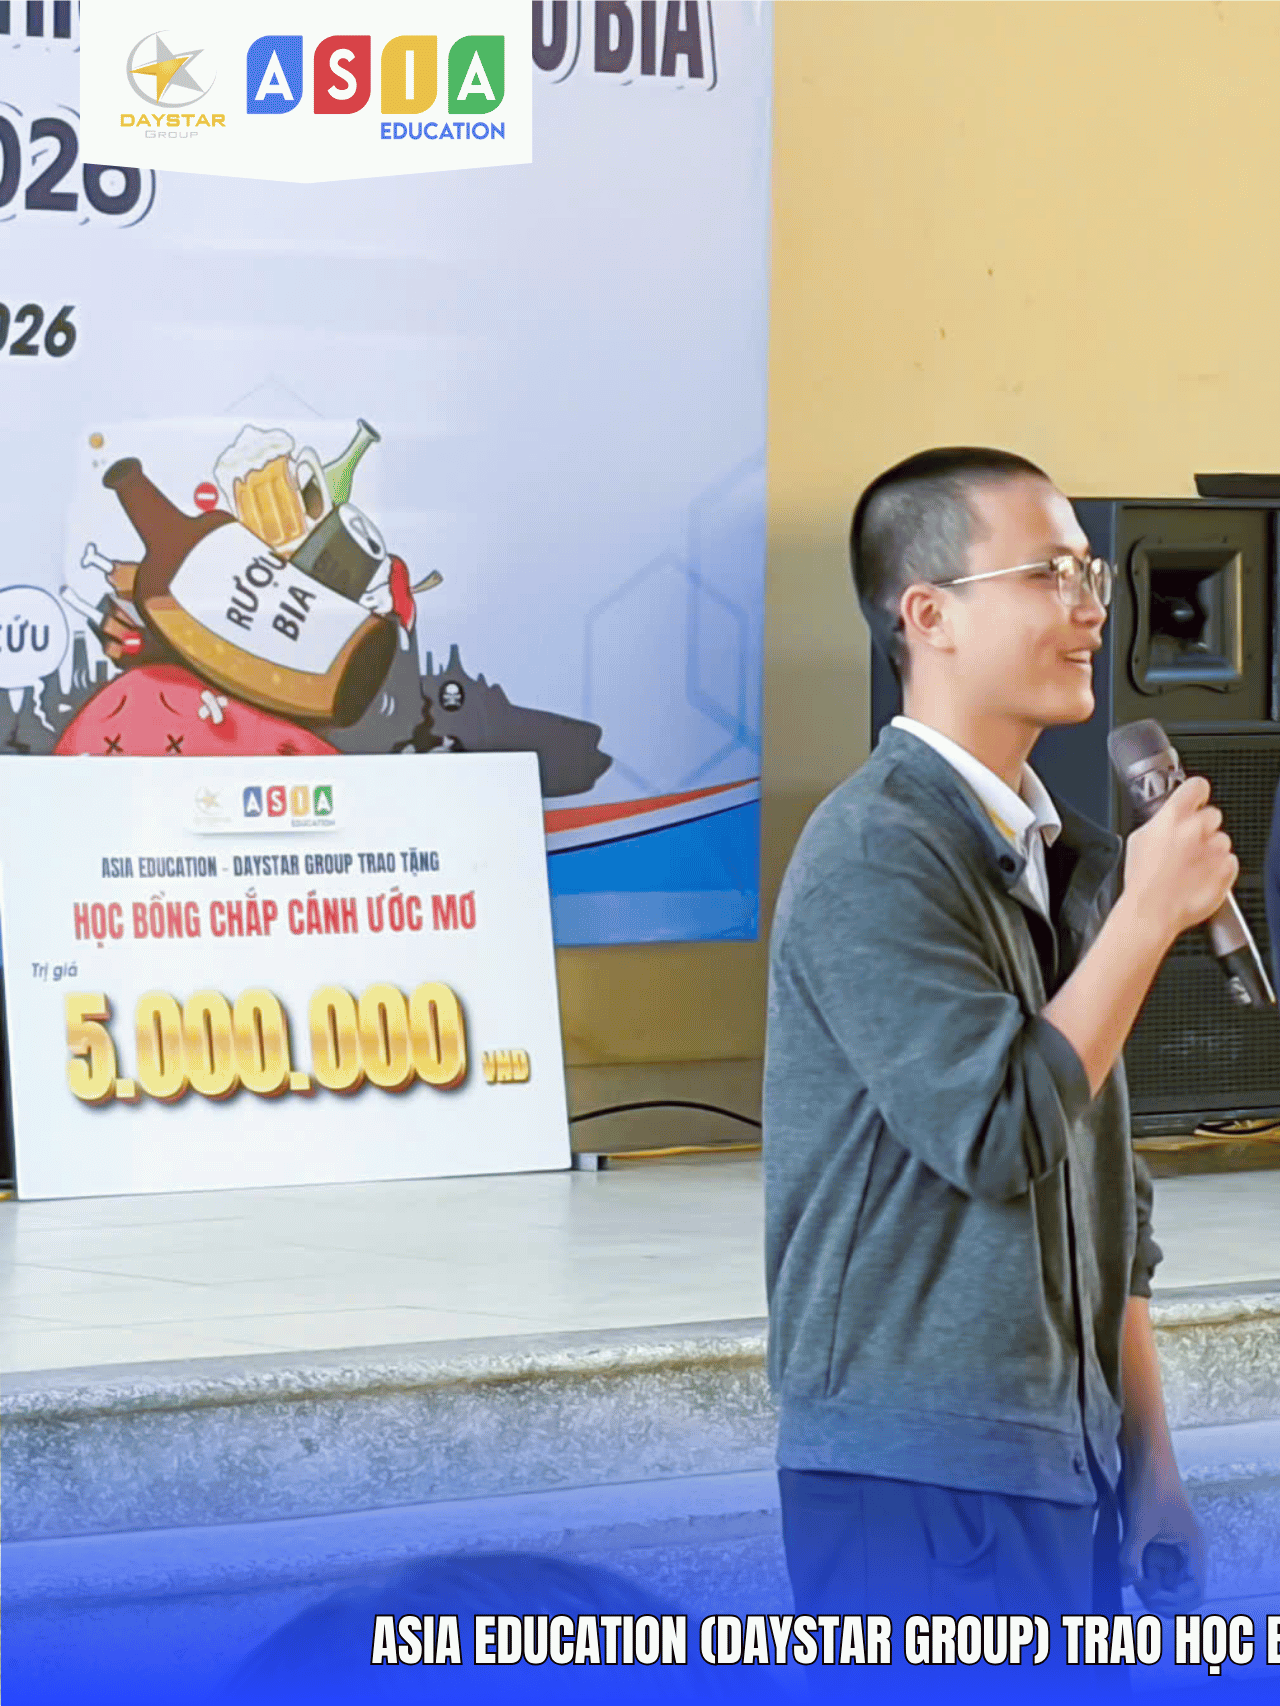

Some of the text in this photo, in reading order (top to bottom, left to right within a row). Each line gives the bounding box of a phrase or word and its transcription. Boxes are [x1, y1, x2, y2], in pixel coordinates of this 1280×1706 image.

[594, 0, 704, 79] BIA
[0, 614, 49, 653] ỨU
[272, 585, 318, 642] BIA
[245, 788, 332, 814] ASIA
[102, 856, 134, 878] ASIA
[138, 856, 218, 878] EDUCATION
[233, 854, 300, 877] DAYSTAR
[304, 853, 353, 875] GROUP
[357, 852, 396, 874] TRAO
[400, 847, 440, 877] TẶNG
[74, 901, 124, 948] HỌC
[210, 886, 278, 937] CHẮP
[287, 890, 359, 935] CÁNH
[366, 886, 423, 933] ƯỚC
[431, 890, 477, 931] MƠ
[52, 961, 78, 982] giá
[64, 981, 468, 1103] 5.000.000
